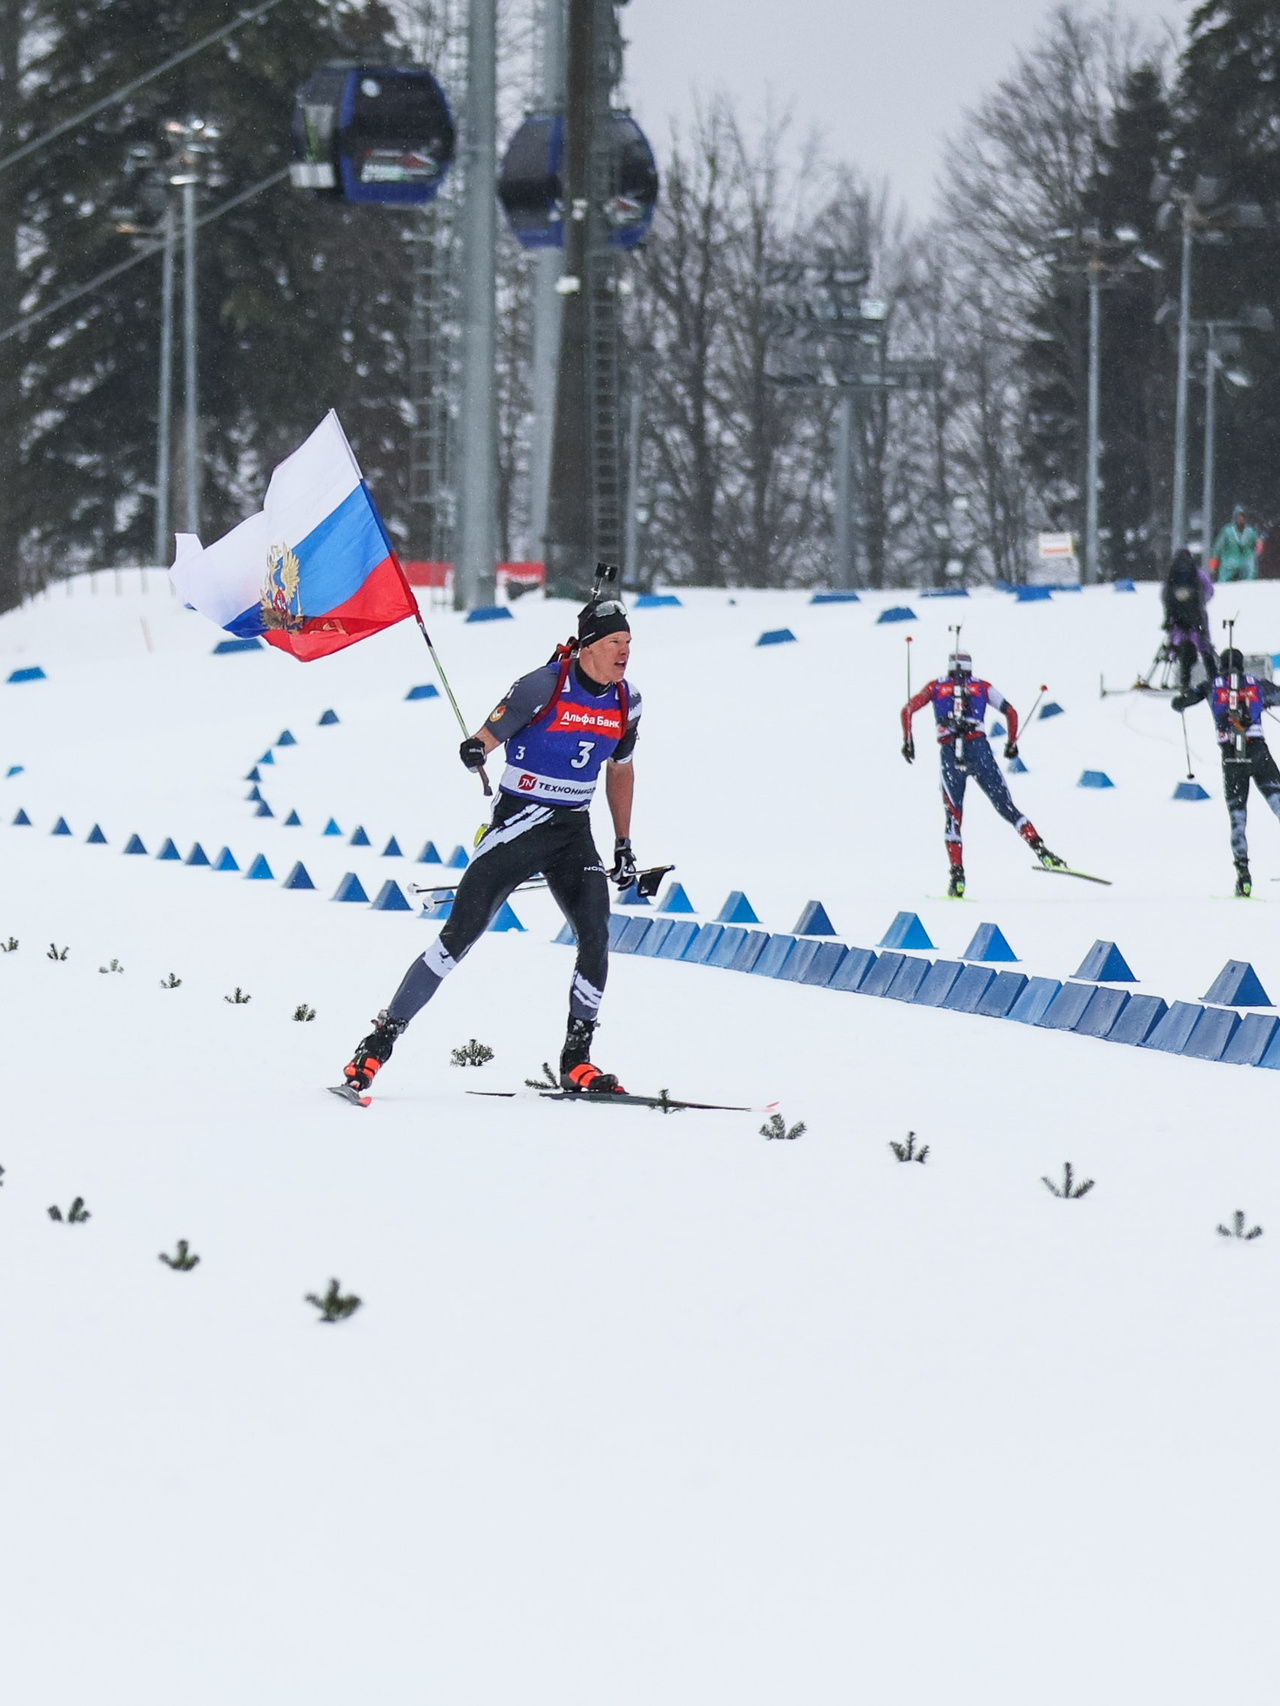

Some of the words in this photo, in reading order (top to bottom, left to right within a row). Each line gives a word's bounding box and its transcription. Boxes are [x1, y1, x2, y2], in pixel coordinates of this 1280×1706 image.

[560, 711, 596, 726] Альфа
[596, 715, 620, 729] Банк
[515, 745, 526, 760] 3
[570, 740, 596, 769] 3
